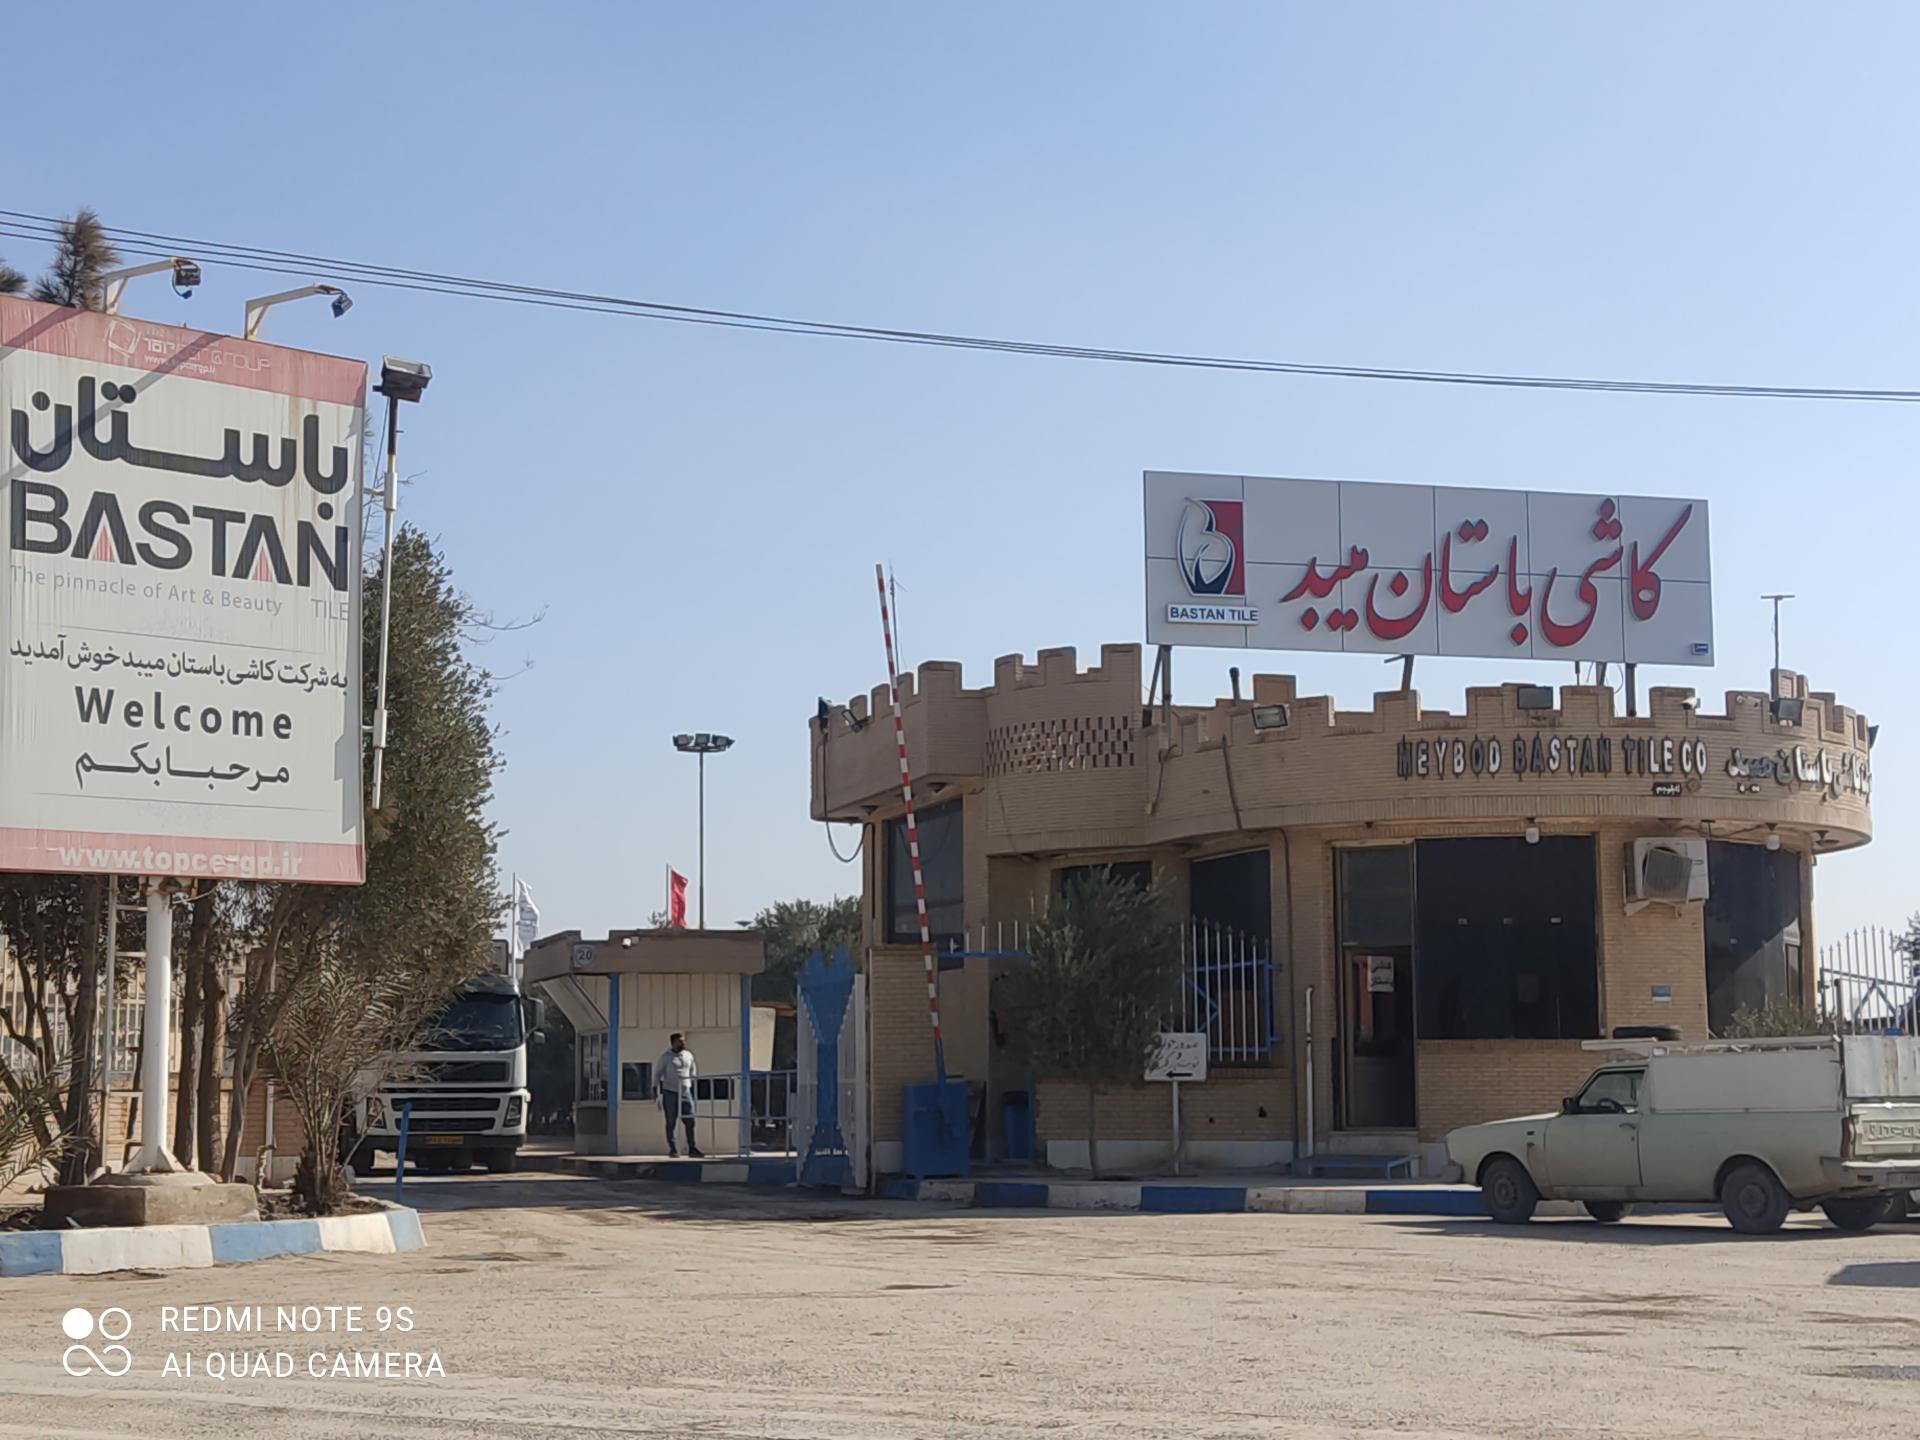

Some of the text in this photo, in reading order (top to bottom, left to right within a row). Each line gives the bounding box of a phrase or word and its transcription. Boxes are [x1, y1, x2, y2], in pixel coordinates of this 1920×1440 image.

[11, 376, 348, 520] باستان
[10, 479, 349, 592] BASTAN
[10, 564, 283, 617] The pinnacle of Art & Beauty
[1279, 498, 1693, 648] کاشی باستان میبد
[310, 598, 349, 621] TILE
[1169, 607, 1259, 621] BASTAN TILE
[10, 634, 349, 695] به شرکت کاشی باستان میبد خوش آمدید
[74, 686, 293, 740] Welcome
[166, 745, 290, 791] مرحبا
[1397, 738, 1500, 776] MEYBOD
[1513, 737, 1612, 776] BASTAN
[578, 949, 593, 961] 20
